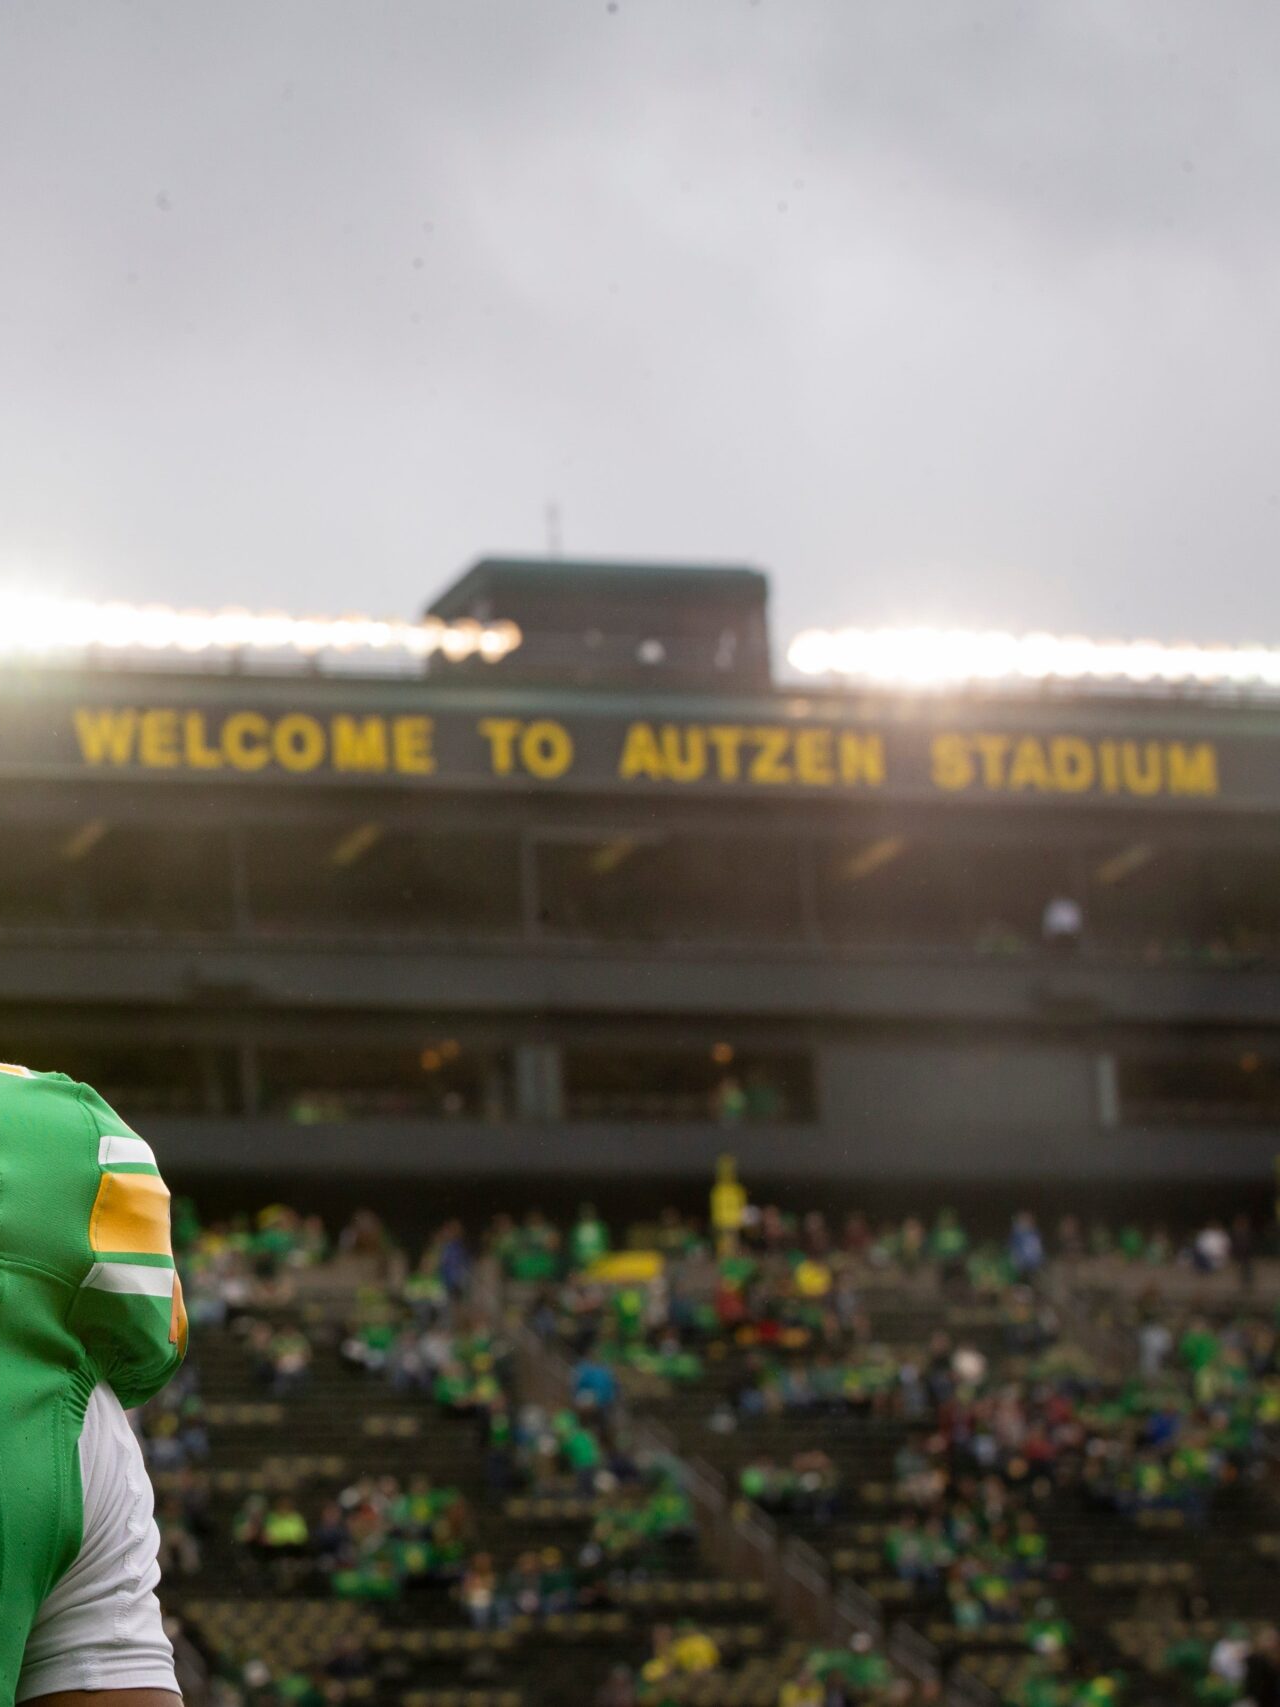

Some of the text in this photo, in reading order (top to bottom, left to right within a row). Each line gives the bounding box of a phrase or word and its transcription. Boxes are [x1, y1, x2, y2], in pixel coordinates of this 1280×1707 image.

[74, 709, 1217, 797] WELCOME TO AUTZEN STADIUM
